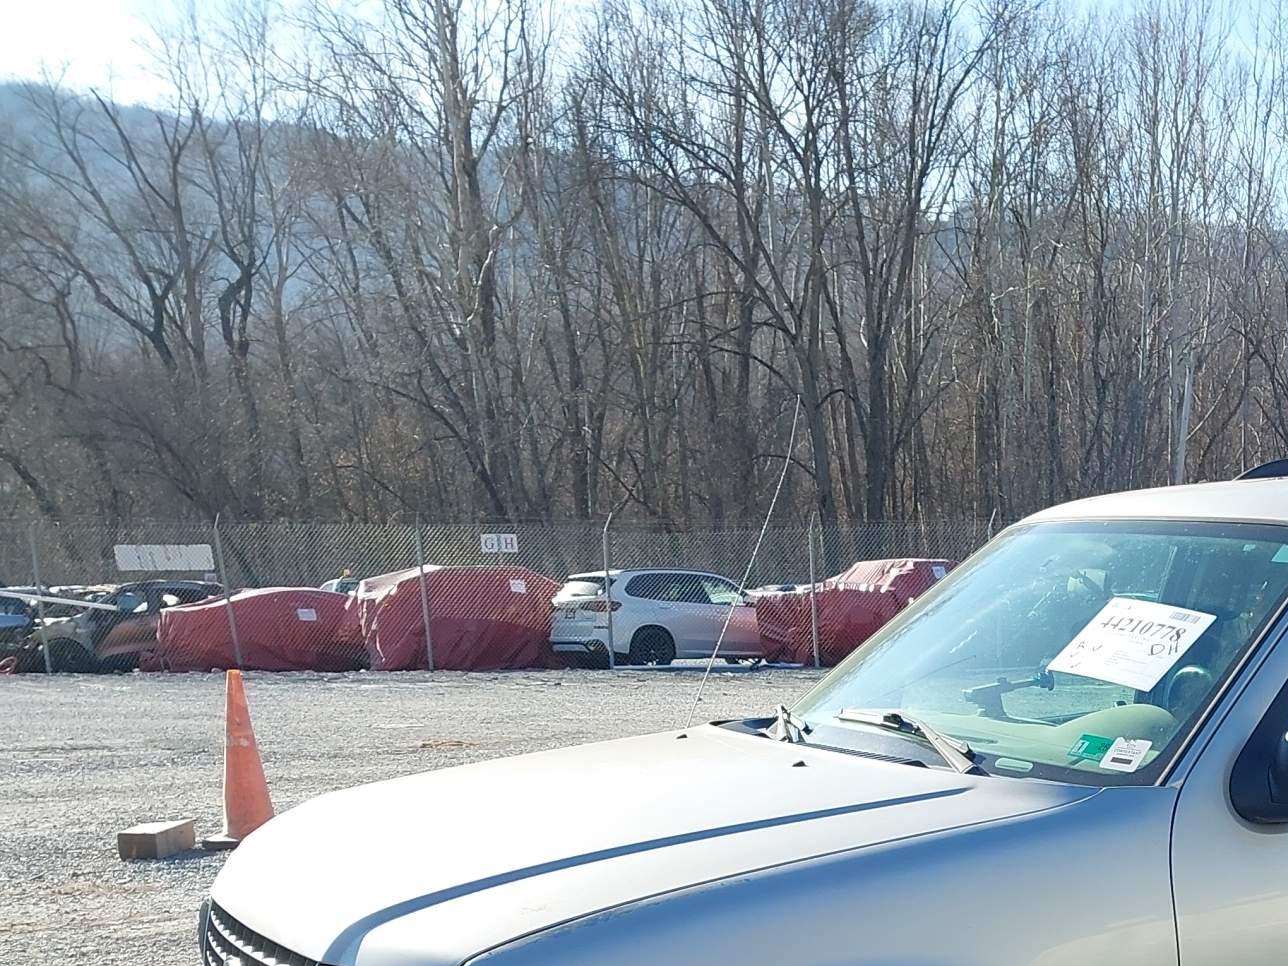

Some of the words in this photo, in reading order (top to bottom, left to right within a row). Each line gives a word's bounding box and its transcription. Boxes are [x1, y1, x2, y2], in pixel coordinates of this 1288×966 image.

[484, 537, 495, 550] G
[504, 537, 514, 550] H
[1101, 615, 1187, 643] 44210778
